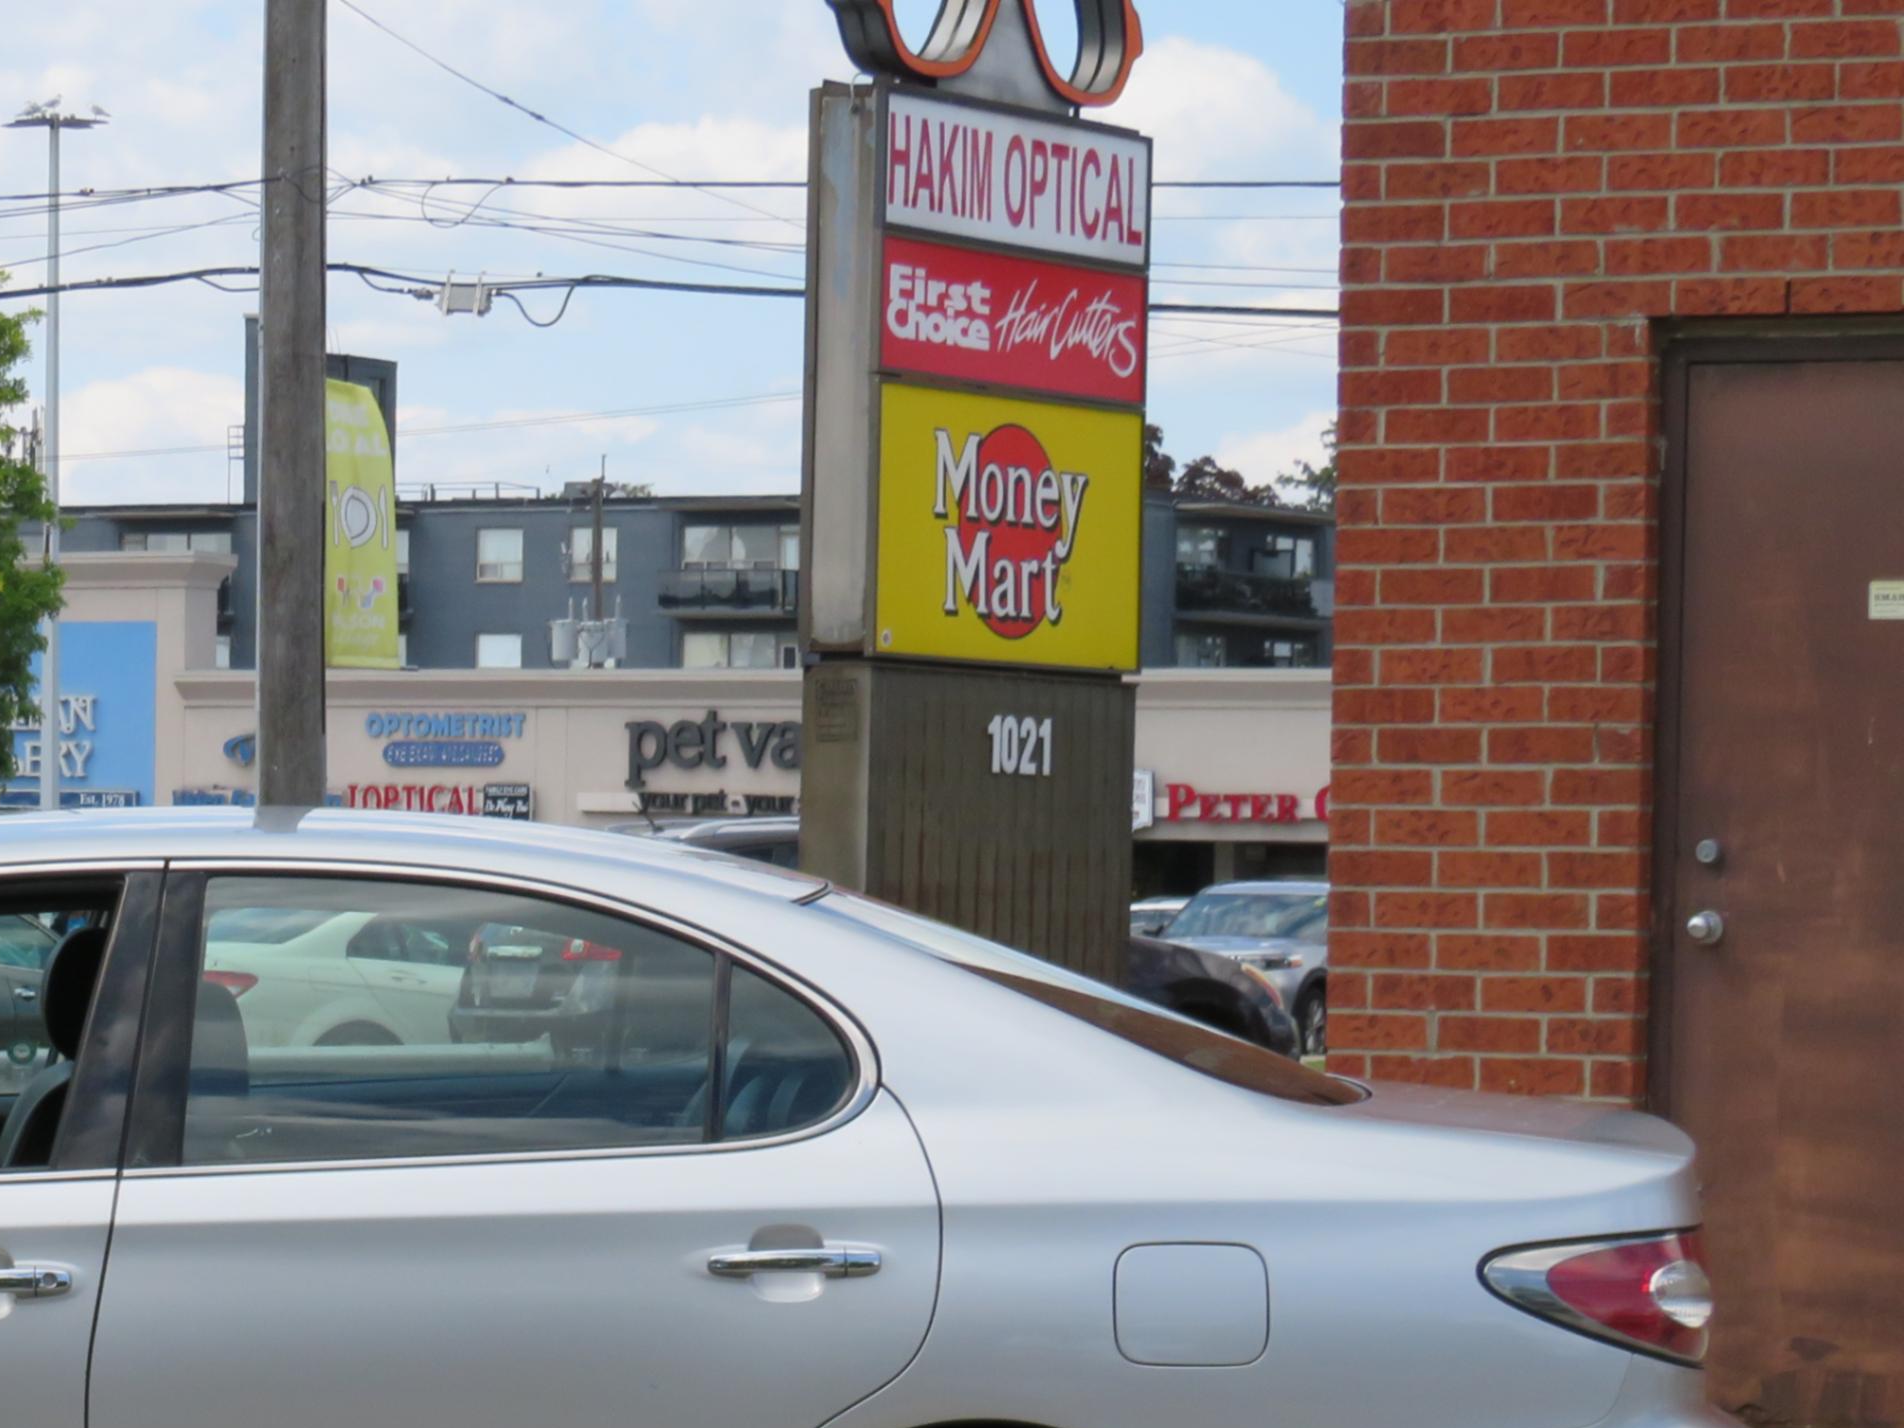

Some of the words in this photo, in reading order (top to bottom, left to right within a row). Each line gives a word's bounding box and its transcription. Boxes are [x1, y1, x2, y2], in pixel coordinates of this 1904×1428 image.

[888, 112, 993, 222] HAKIM
[1004, 134, 1142, 246] OPTICAL
[889, 263, 992, 315] First
[887, 298, 990, 352] Choice
[994, 279, 1049, 353] Hair
[1048, 289, 1137, 378] Cutters
[933, 427, 1090, 562] Money
[943, 525, 1063, 627] Mart
[365, 712, 527, 739] OPTOMETRIST
[624, 709, 728, 790] pet
[987, 714, 1053, 776] 1021
[79, 793, 99, 806] Est.
[1165, 783, 1301, 823] PETER
